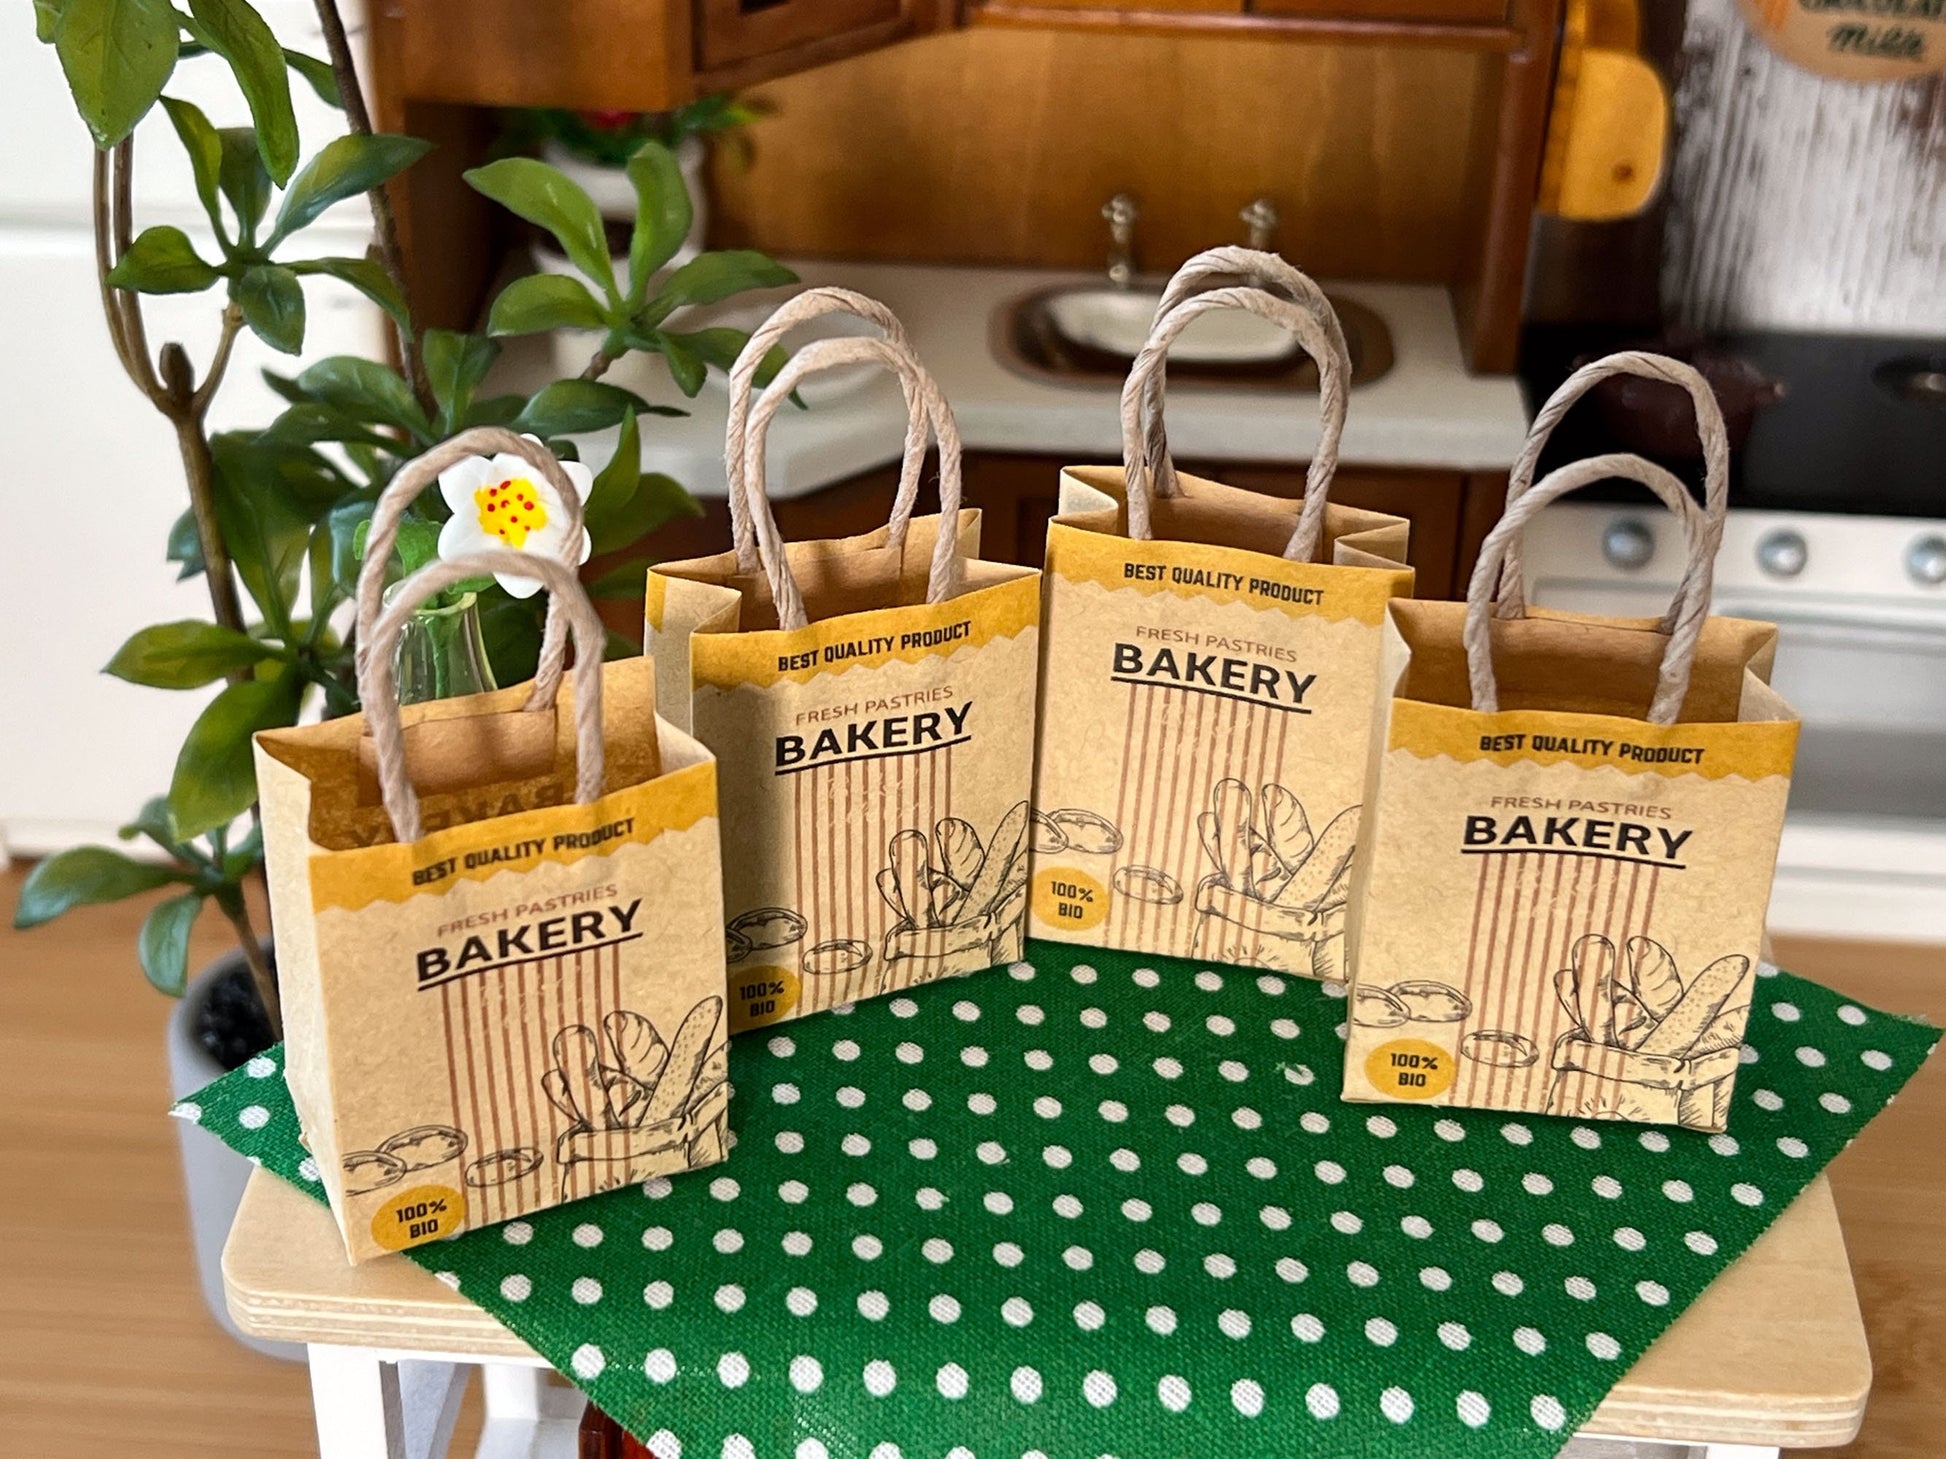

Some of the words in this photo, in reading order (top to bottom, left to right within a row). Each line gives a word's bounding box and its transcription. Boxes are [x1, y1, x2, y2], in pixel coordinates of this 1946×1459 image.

[1124, 563, 1167, 581] BEST
[1172, 567, 1244, 591] QUALITY
[1249, 578, 1324, 605] PRODUCT
[778, 650, 819, 672] BEST
[824, 636, 895, 663] QUALITY
[901, 621, 971, 650] PRODUCT
[1136, 625, 1199, 645] FRESH
[1205, 635, 1297, 663] PASTRIES
[1112, 642, 1317, 704] BAKERY
[795, 702, 858, 726] FRESH
[865, 685, 953, 714] PASTRIES
[775, 701, 973, 767] BAKERY
[1480, 734, 1526, 752] BEST
[1532, 735, 1614, 756] QUALITY
[1619, 743, 1705, 765] PRODUCT
[1490, 796, 1561, 810] FRESH
[1568, 799, 1672, 820] PASTRIES
[412, 857, 458, 886] BEST
[464, 838, 547, 870] QUALITY
[553, 817, 635, 851] PRODUCT
[1463, 815, 1693, 860] BAKERY
[1051, 881, 1093, 903] 100%
[437, 908, 508, 938] FRESH
[516, 883, 618, 918] PASTRIES
[1058, 902, 1083, 920] BIO
[416, 898, 643, 983] BAKERY
[739, 980, 785, 1001] 100%
[750, 1000, 776, 1017] BIO
[1391, 1053, 1438, 1070] 100%
[1398, 1072, 1426, 1088] BIO
[396, 1198, 447, 1224] 100%
[409, 1218, 439, 1239] BIO
